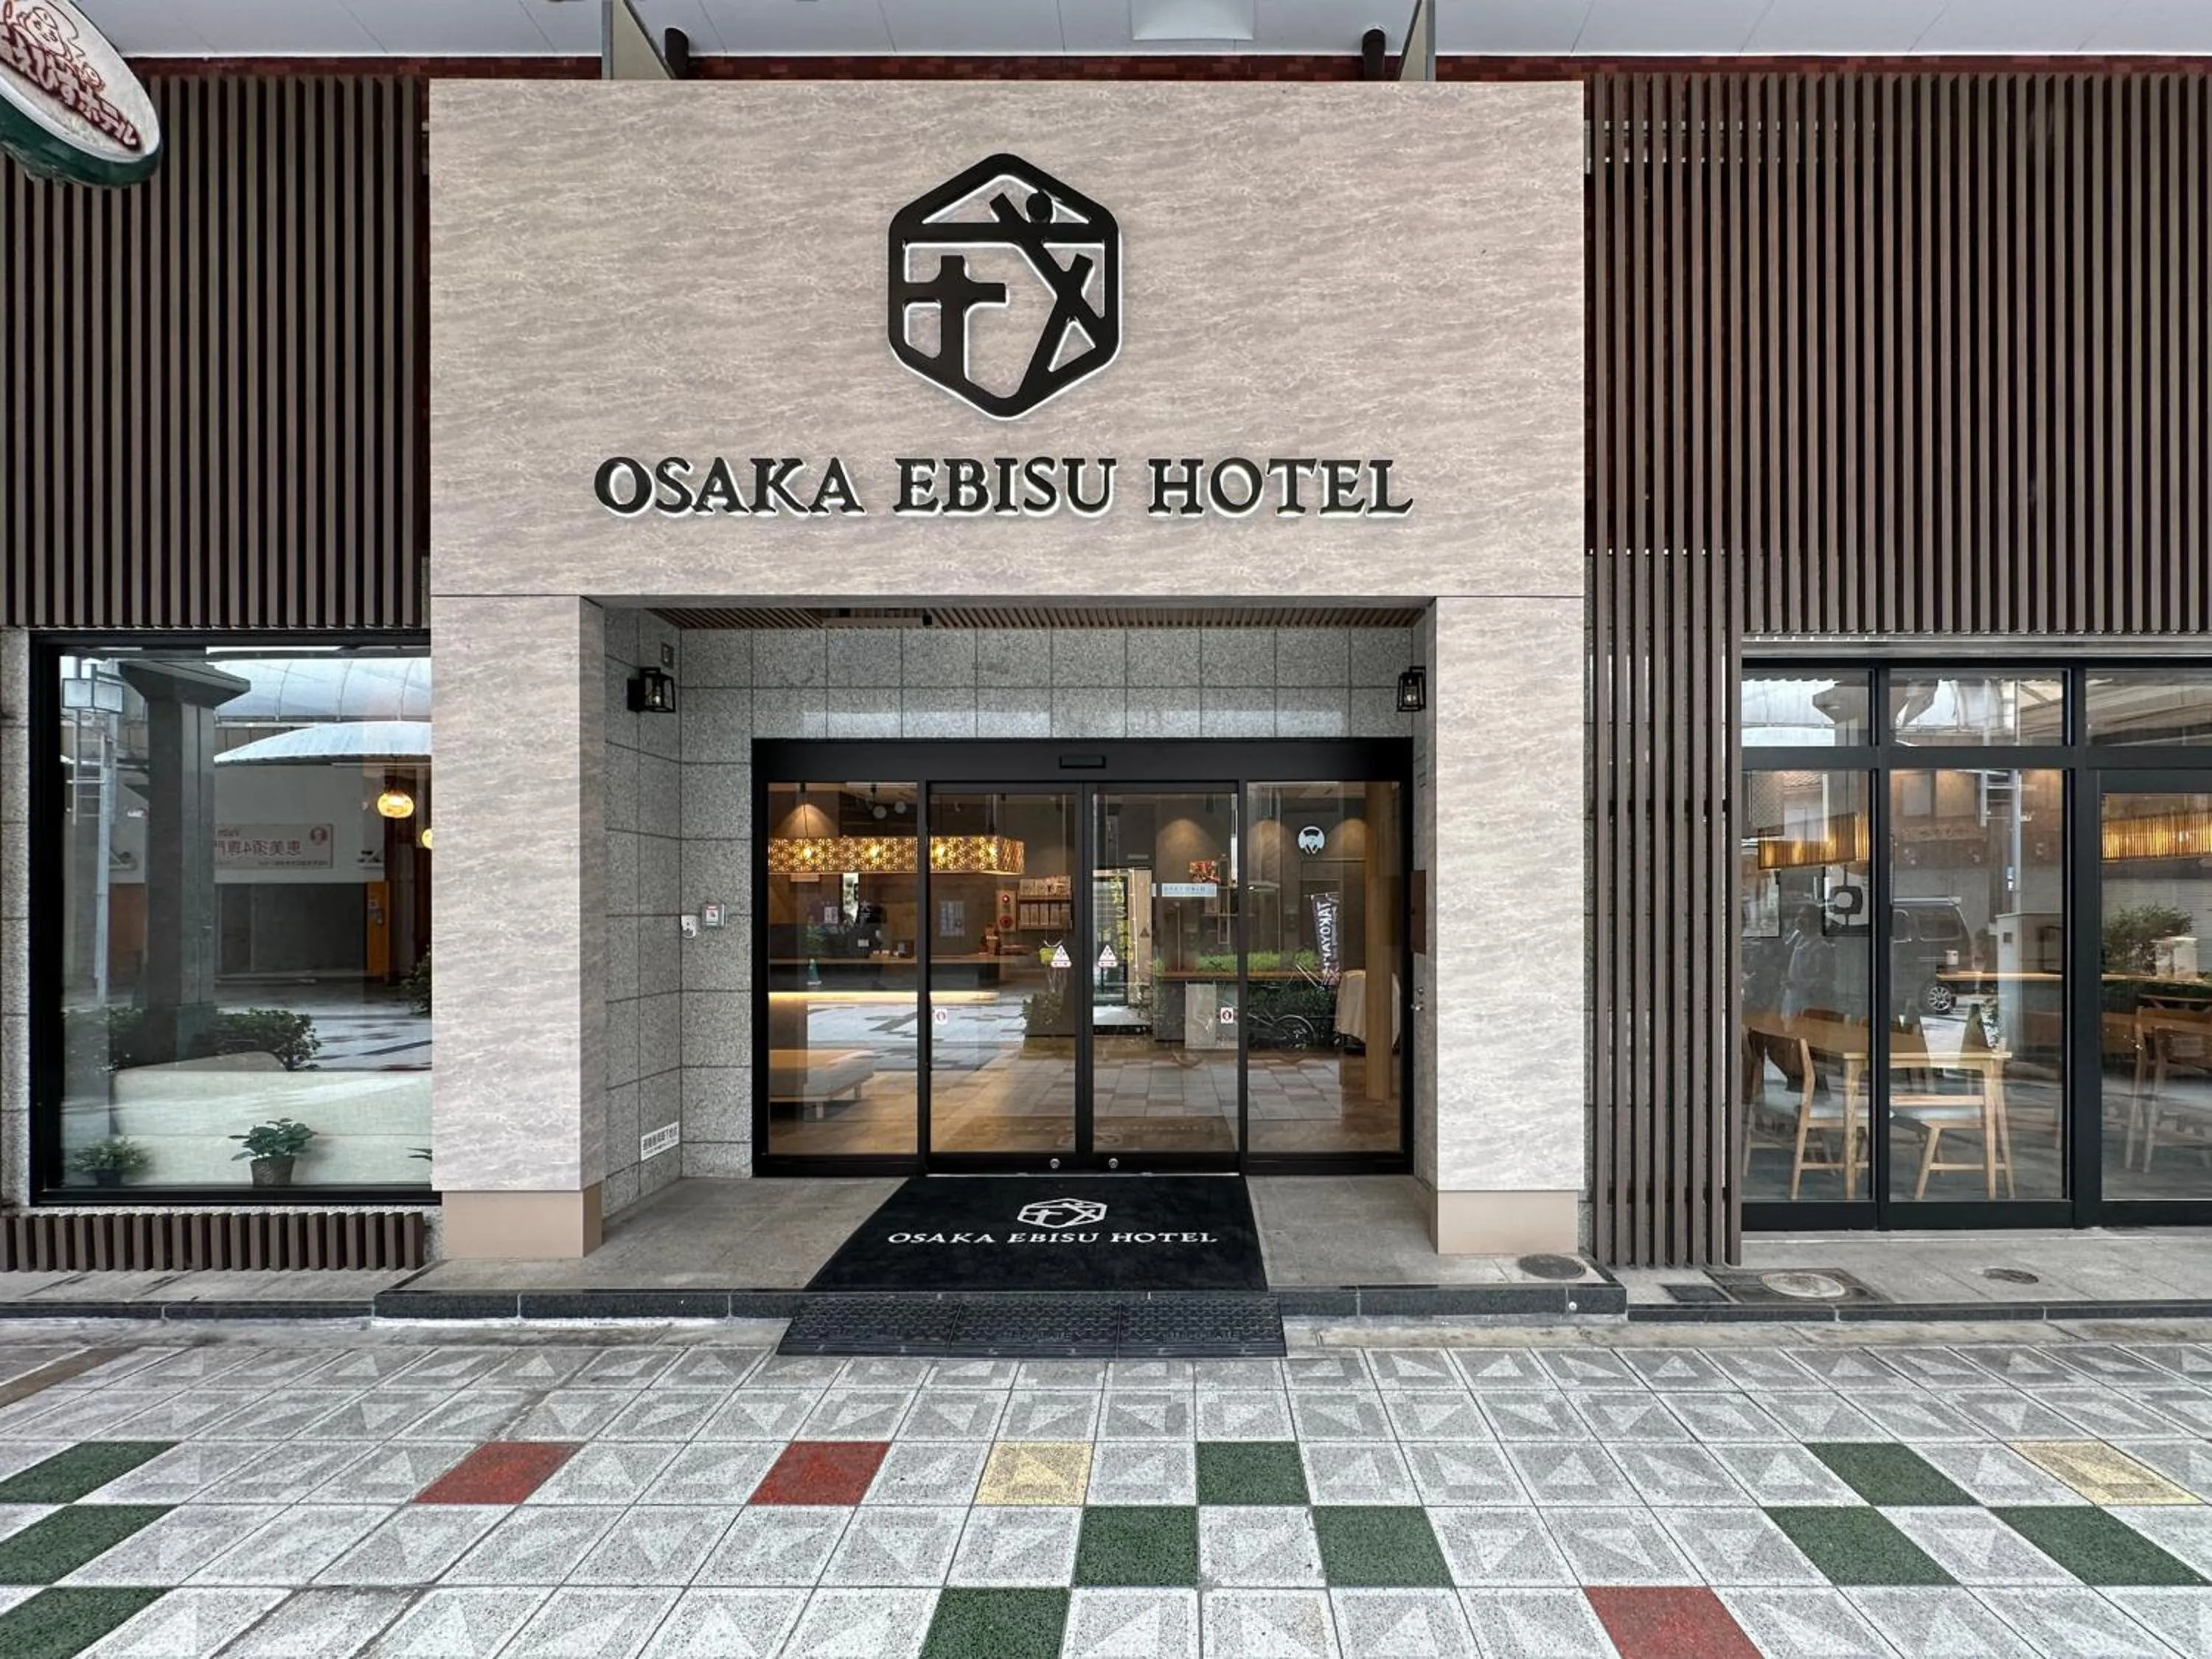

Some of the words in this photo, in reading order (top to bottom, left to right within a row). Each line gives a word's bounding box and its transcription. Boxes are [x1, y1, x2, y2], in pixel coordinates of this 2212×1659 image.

[594, 456, 866, 515] OSAKA
[893, 456, 1118, 515] EBISU
[1147, 456, 1414, 515] HOTEL
[887, 1231, 996, 1244] OSAKA
[1006, 1231, 1100, 1243] EBISU
[1110, 1231, 1219, 1243] HOTEL
